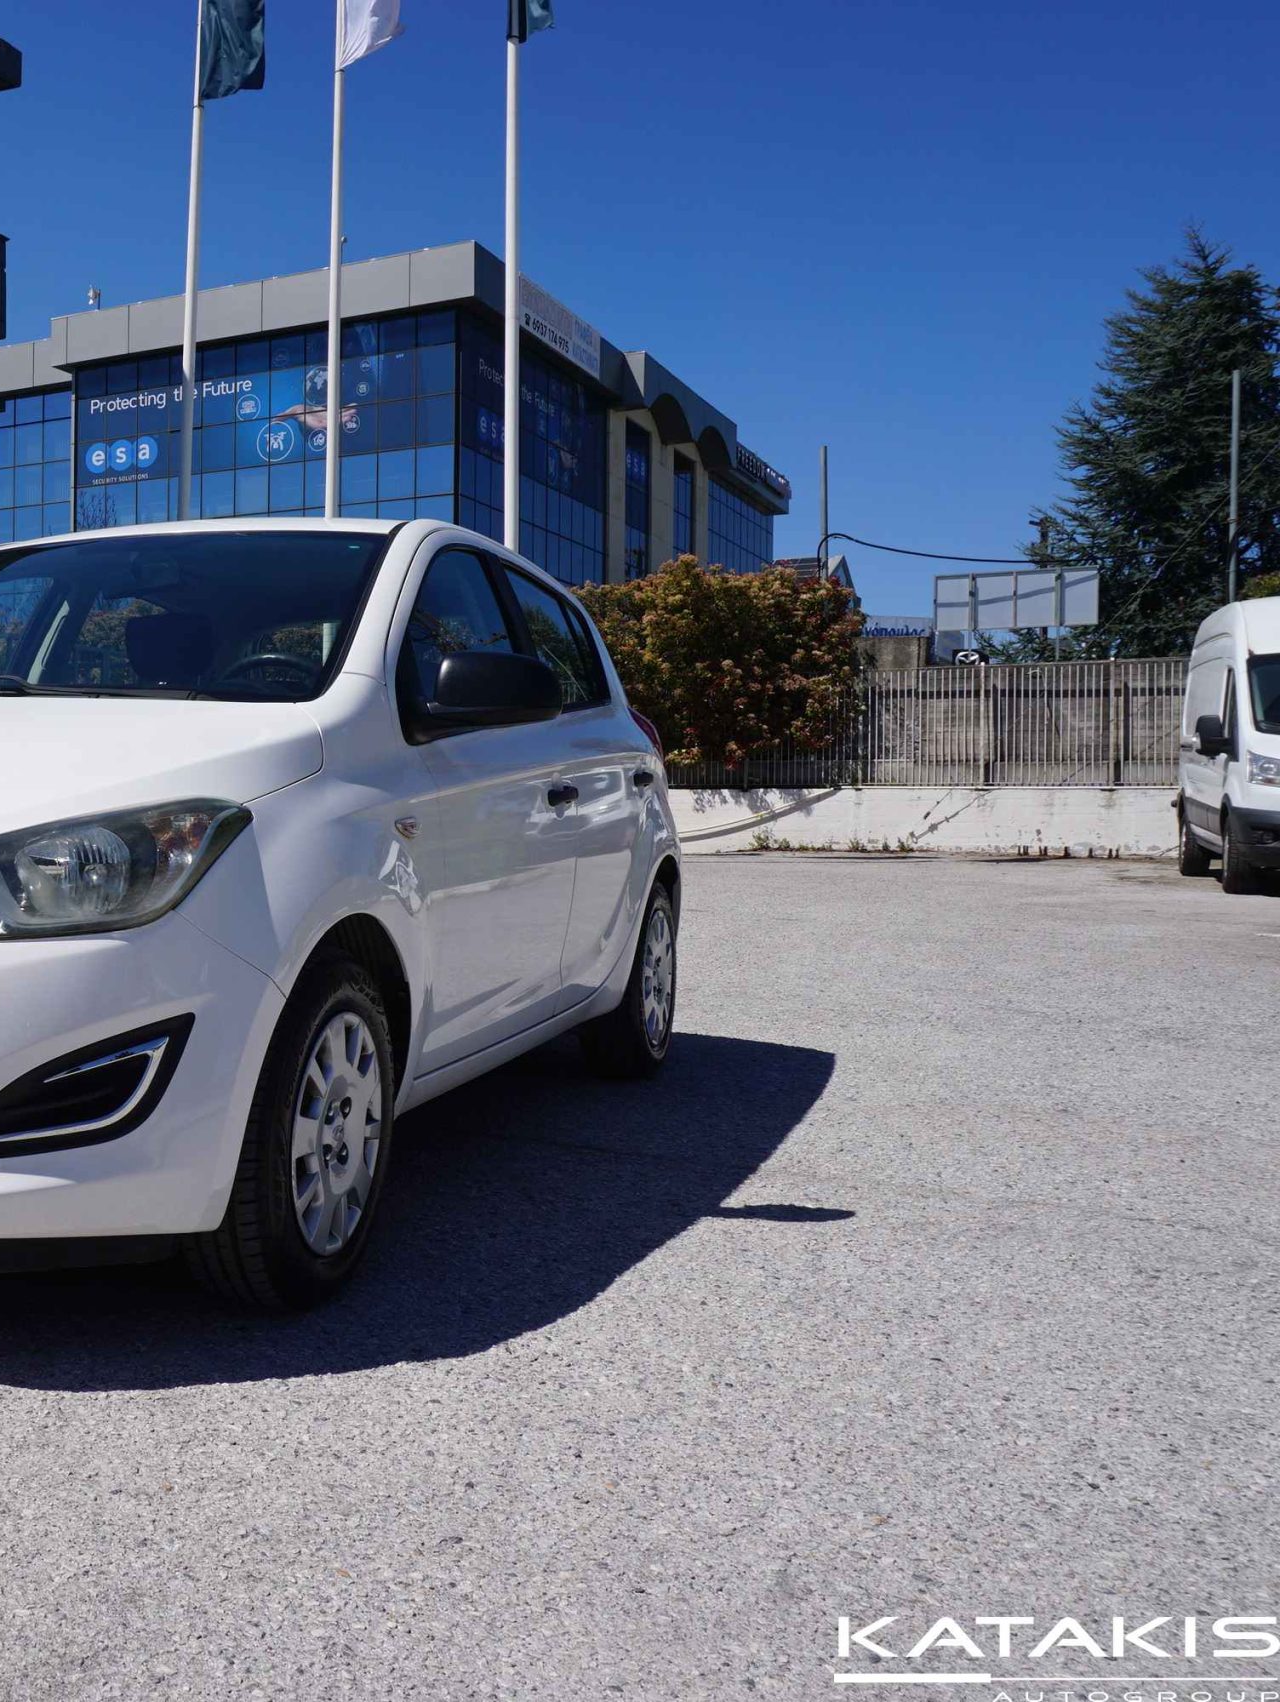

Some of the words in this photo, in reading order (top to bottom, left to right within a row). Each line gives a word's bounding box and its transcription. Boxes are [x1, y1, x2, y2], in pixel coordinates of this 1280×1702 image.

[478, 358, 505, 387] Protec
[90, 391, 167, 414] Protecting
[203, 379, 253, 398] Future
[89, 441, 153, 468] esa
[92, 476, 118, 486] SECURITY
[118, 472, 149, 483] SOLUTIONS
